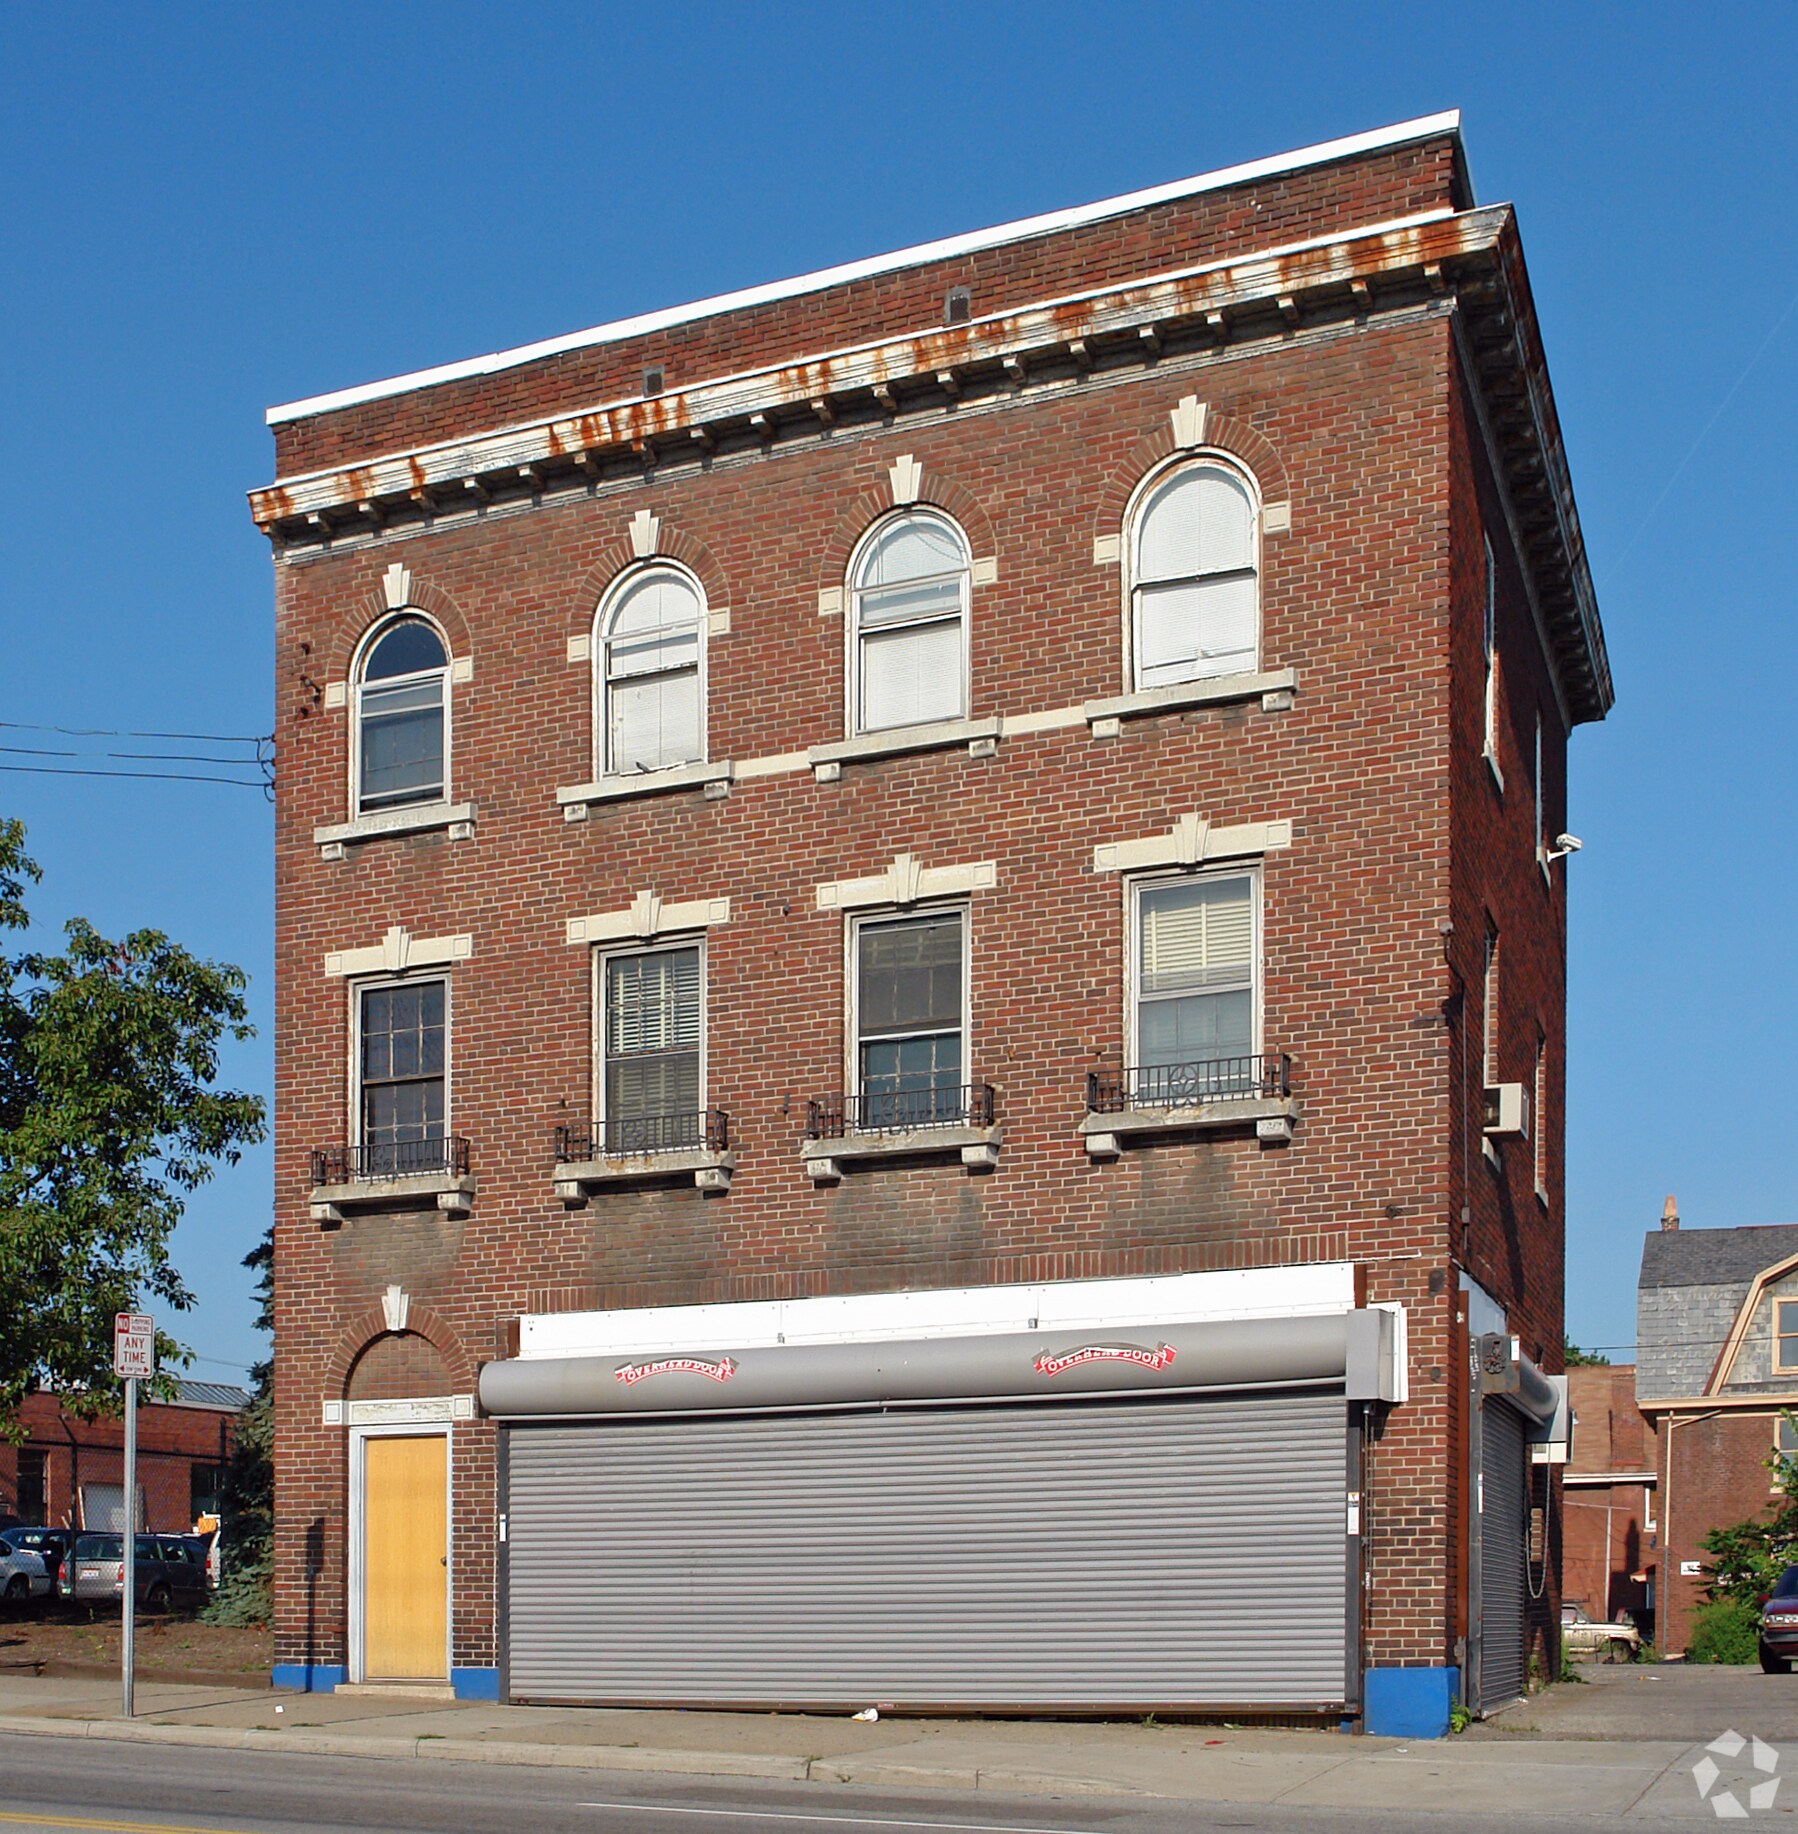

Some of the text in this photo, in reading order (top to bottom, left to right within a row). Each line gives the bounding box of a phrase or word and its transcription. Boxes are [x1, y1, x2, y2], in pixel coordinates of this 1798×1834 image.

[118, 1317, 129, 1330] NO
[124, 1336, 145, 1349] ANY
[123, 1350, 146, 1364] TIME
[1122, 1348, 1160, 1368] DOOR
[626, 1359, 724, 1380] OVERHEAD DOOR
